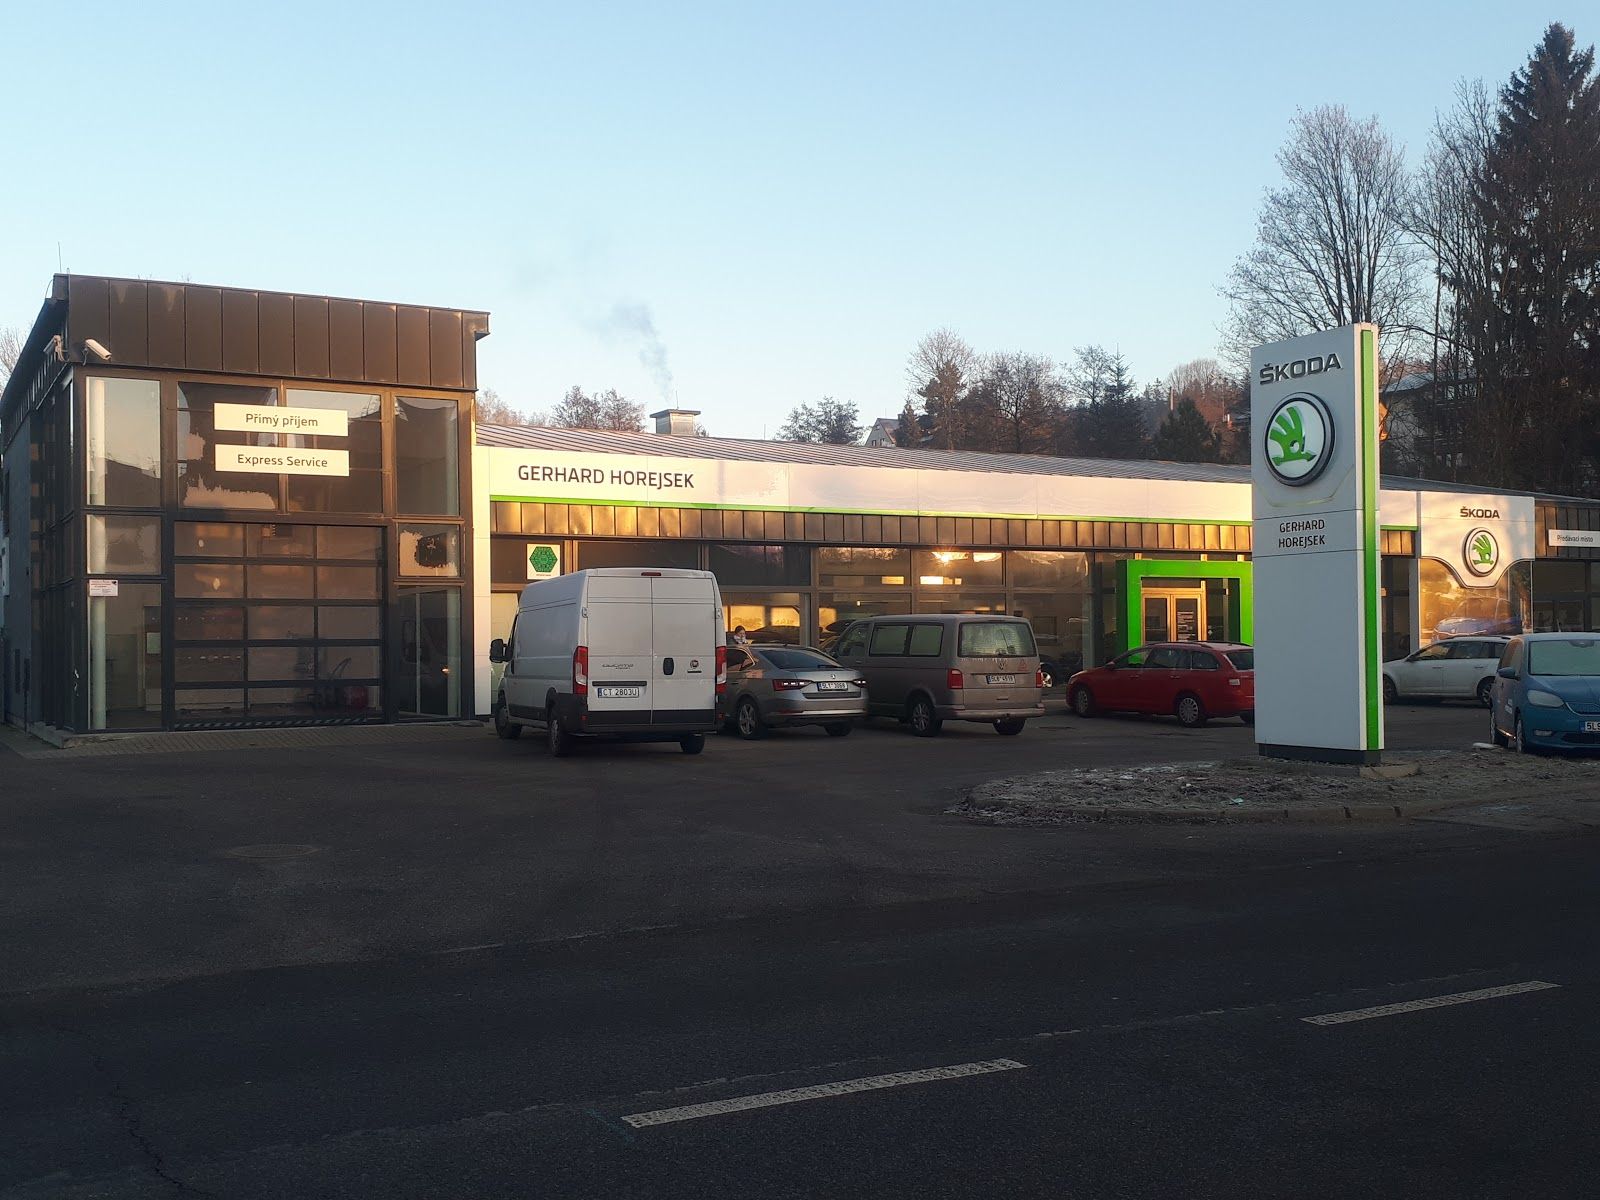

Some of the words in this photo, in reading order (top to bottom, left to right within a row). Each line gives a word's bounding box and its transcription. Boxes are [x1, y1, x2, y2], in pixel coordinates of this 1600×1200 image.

[1260, 353, 1342, 385] ŠKODA
[245, 413, 279, 427] Přímý
[282, 415, 319, 428] příjem
[237, 454, 283, 466] Express
[286, 456, 328, 467] Service
[518, 465, 605, 484] GERHARD
[610, 470, 695, 490] HOREJSEK
[1460, 506, 1500, 519] ŠKODA
[1279, 520, 1325, 533] GERHARD
[1278, 535, 1326, 549] HOREJSEK
[603, 688, 612, 696] CT
